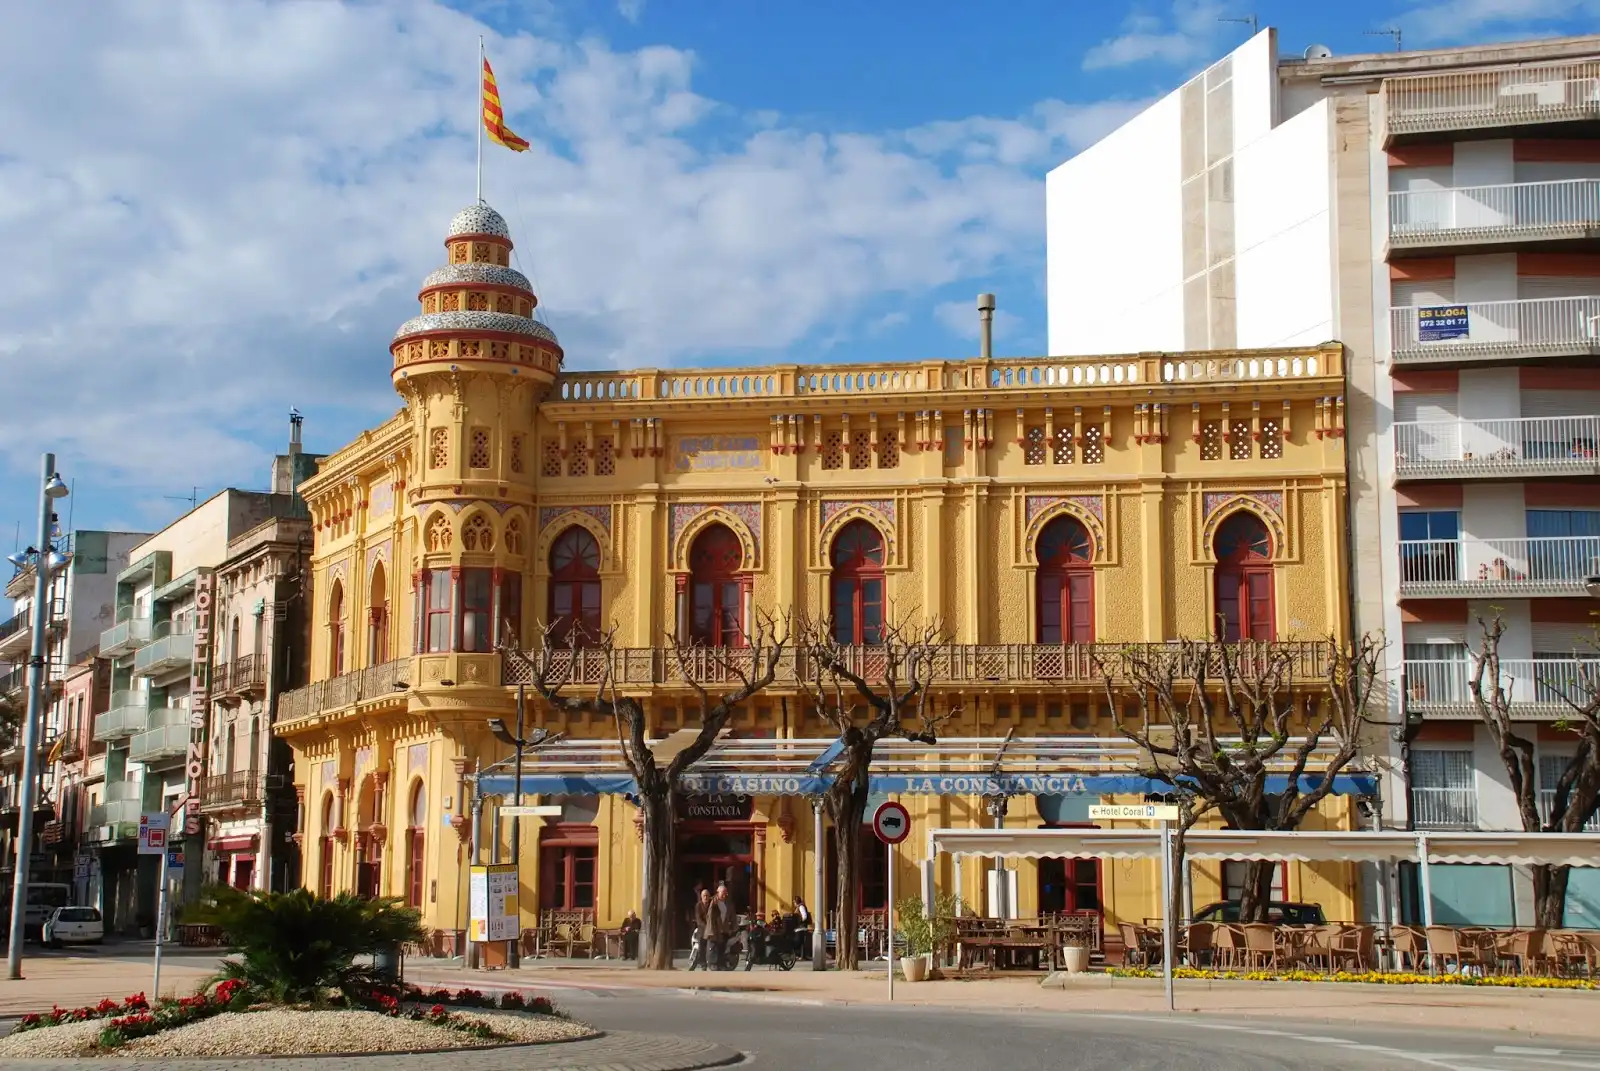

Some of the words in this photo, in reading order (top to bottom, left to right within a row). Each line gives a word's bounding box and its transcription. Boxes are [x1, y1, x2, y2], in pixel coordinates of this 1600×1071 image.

[1420, 310, 1432, 318] ES
[1435, 308, 1466, 317] LLOGA
[193, 574, 211, 663] HOTEL
[191, 675, 206, 729] LES
[185, 742, 204, 834] NOIES
[718, 778, 800, 792] CASINO
[905, 778, 936, 792] LA
[939, 777, 1088, 793] CONSTANCIA
[708, 793, 723, 803] LA
[688, 805, 741, 817] CONSTANCIA
[1100, 806, 1121, 816] Hotel
[1123, 806, 1144, 816] Coral
